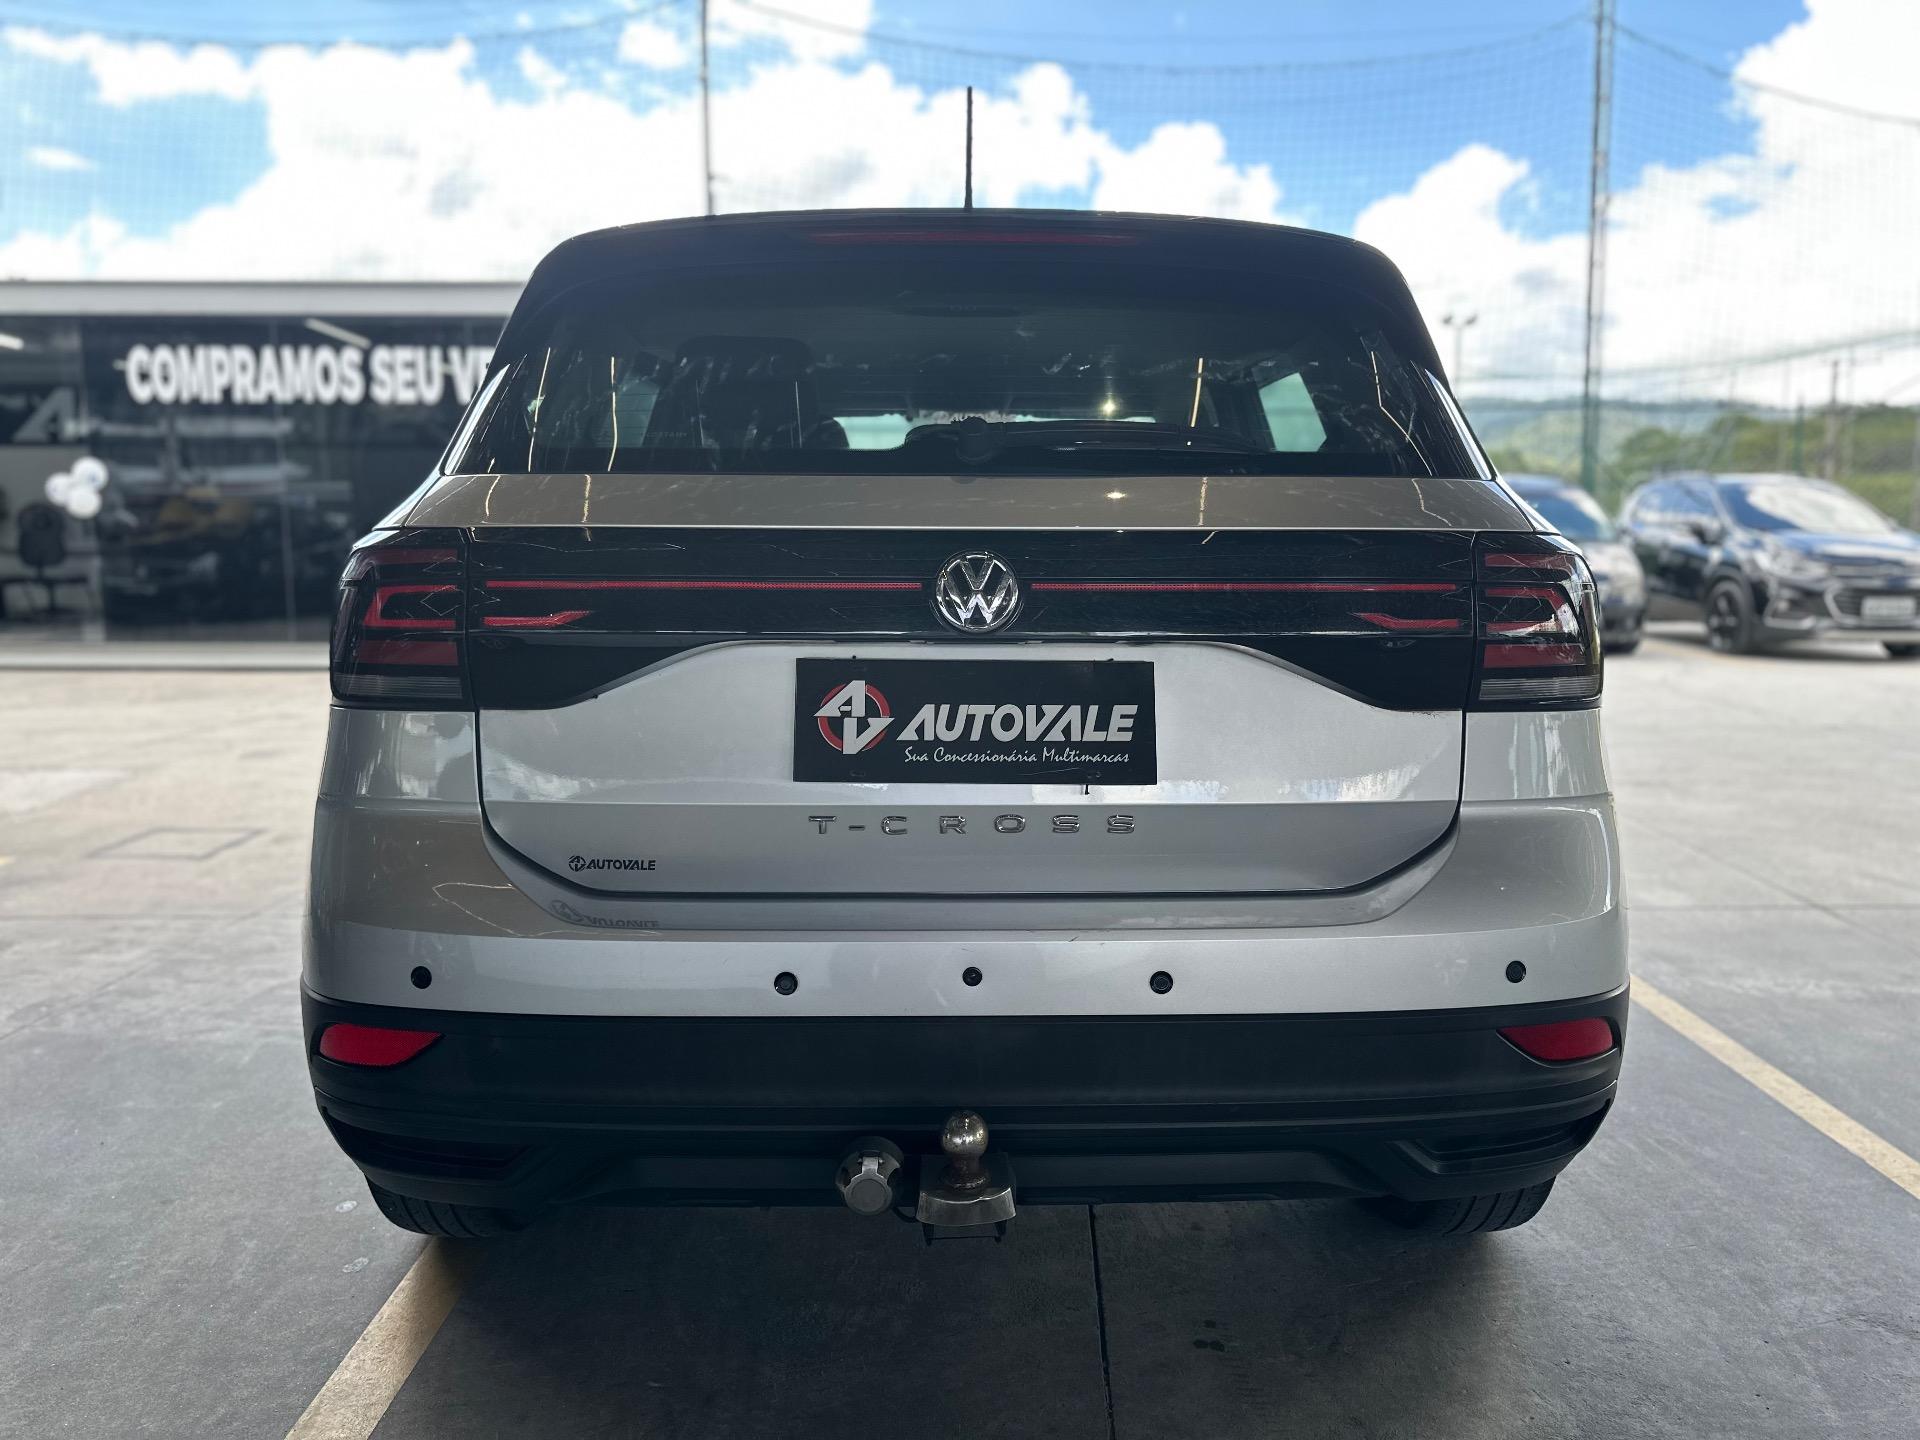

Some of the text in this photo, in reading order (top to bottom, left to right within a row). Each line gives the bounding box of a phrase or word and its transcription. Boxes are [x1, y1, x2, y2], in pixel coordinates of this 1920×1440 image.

[126, 344, 366, 404] COMPRAMOS
[370, 346, 443, 404] SEU
[896, 704, 1139, 742] AUTOVALE
[904, 746, 1130, 763] Sua Concessionária Multimarcas
[808, 813, 1136, 835] T-CROSS
[586, 859, 656, 871] AUTOVALE
